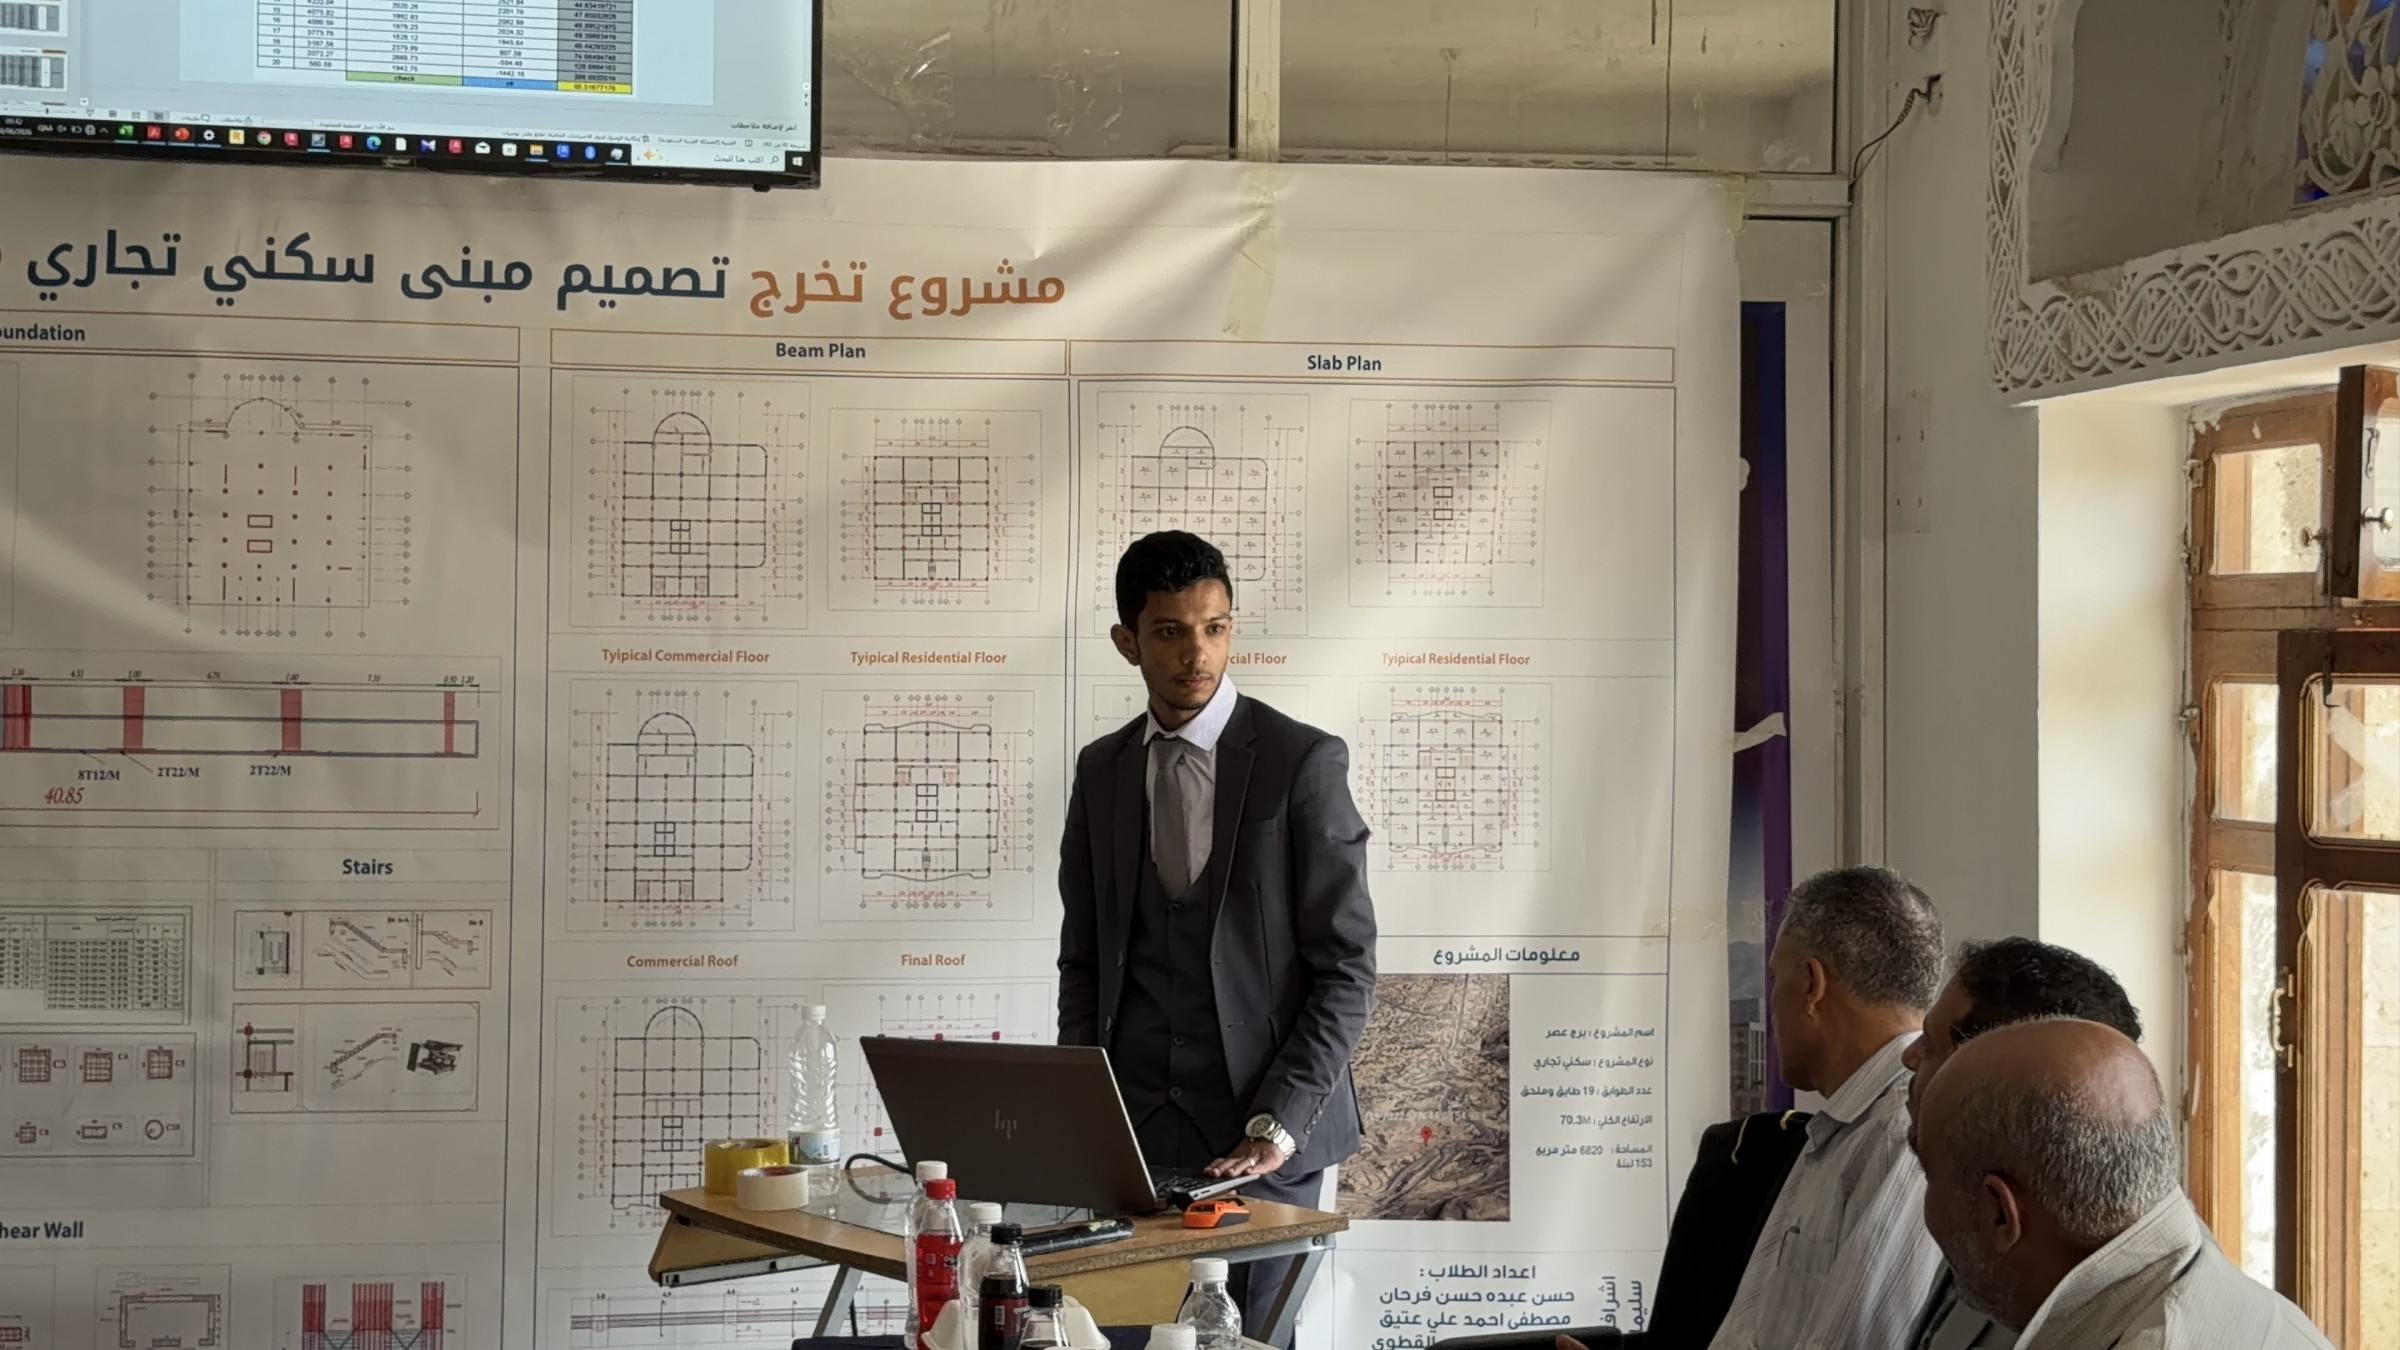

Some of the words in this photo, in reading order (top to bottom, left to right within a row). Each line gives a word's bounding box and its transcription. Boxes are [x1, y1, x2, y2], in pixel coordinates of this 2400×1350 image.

[27, 229, 181, 301] تجاري
[204, 232, 375, 306] سكني
[401, 246, 533, 303] مبنى
[557, 256, 730, 311] تصميم
[750, 260, 867, 318] تخرج
[888, 258, 1066, 321] مشروع
[0, 322, 86, 341] undation
[776, 342, 824, 358] Beam
[829, 342, 867, 359] Plan
[1307, 354, 1343, 372] Slab
[1347, 355, 1382, 372] Plan
[602, 649, 652, 664] Tyipical
[655, 650, 733, 663] Commercial
[736, 650, 770, 663] Floor
[850, 651, 898, 666] Tyipical
[902, 651, 972, 664] Residential
[975, 652, 1007, 664] Floor
[1254, 652, 1287, 664] Floor
[1429, 652, 1496, 665] Residential
[1499, 653, 1530, 665] Floor
[157, 767, 200, 778] 2T22/M
[250, 765, 291, 777] 2T22/M
[44, 787, 85, 805] 40.85
[342, 858, 394, 877] Stairs
[627, 955, 705, 968] Commercial
[708, 955, 739, 968] Roof
[901, 954, 932, 966] Final
[936, 954, 966, 966] Roof
[1433, 944, 1502, 965] المشروع
[1506, 947, 1580, 965] معلومات
[1570, 1028, 1587, 1039] برج
[1593, 1026, 1634, 1039] المشروع
[1635, 1028, 1655, 1039] اسم
[1533, 1056, 1561, 1071] تجاري
[1562, 1056, 1591, 1071] سكني
[1597, 1055, 1637, 1069] المشروع
[1638, 1055, 1654, 1068] نوع
[1520, 1085, 1554, 1097] وملحق
[1556, 1085, 1580, 1097] طابق
[1583, 1086, 1594, 1095] 19
[1602, 1086, 1635, 1098] الطوابق
[1636, 1086, 1652, 1095] عدد
[995, 1109, 1017, 1140] hp
[1560, 1115, 1591, 1125] 70.3M
[1598, 1115, 1621, 1130] الكلي
[1535, 1146, 1559, 1156] مربع
[1560, 1144, 1577, 1156] متر
[1579, 1145, 1603, 1155] 6820
[1615, 1144, 1653, 1154] المساحة
[1636, 1157, 1653, 1168] 153
[44, 1220, 84, 1239] Wall
[1428, 1264, 1488, 1282] الطلاب
[1493, 1264, 1536, 1279] اعداد
[1379, 1286, 1432, 1304] فرحان
[1435, 1291, 1482, 1305] حسن
[1486, 1291, 1527, 1306] عبده
[1531, 1291, 1575, 1306] حسن
[1628, 1280, 1648, 1333] سليما
[1379, 1310, 1422, 1329] عتيق
[1427, 1311, 1458, 1333] علي
[1463, 1312, 1504, 1327] احمد
[1508, 1311, 1571, 1330] مصطفى
